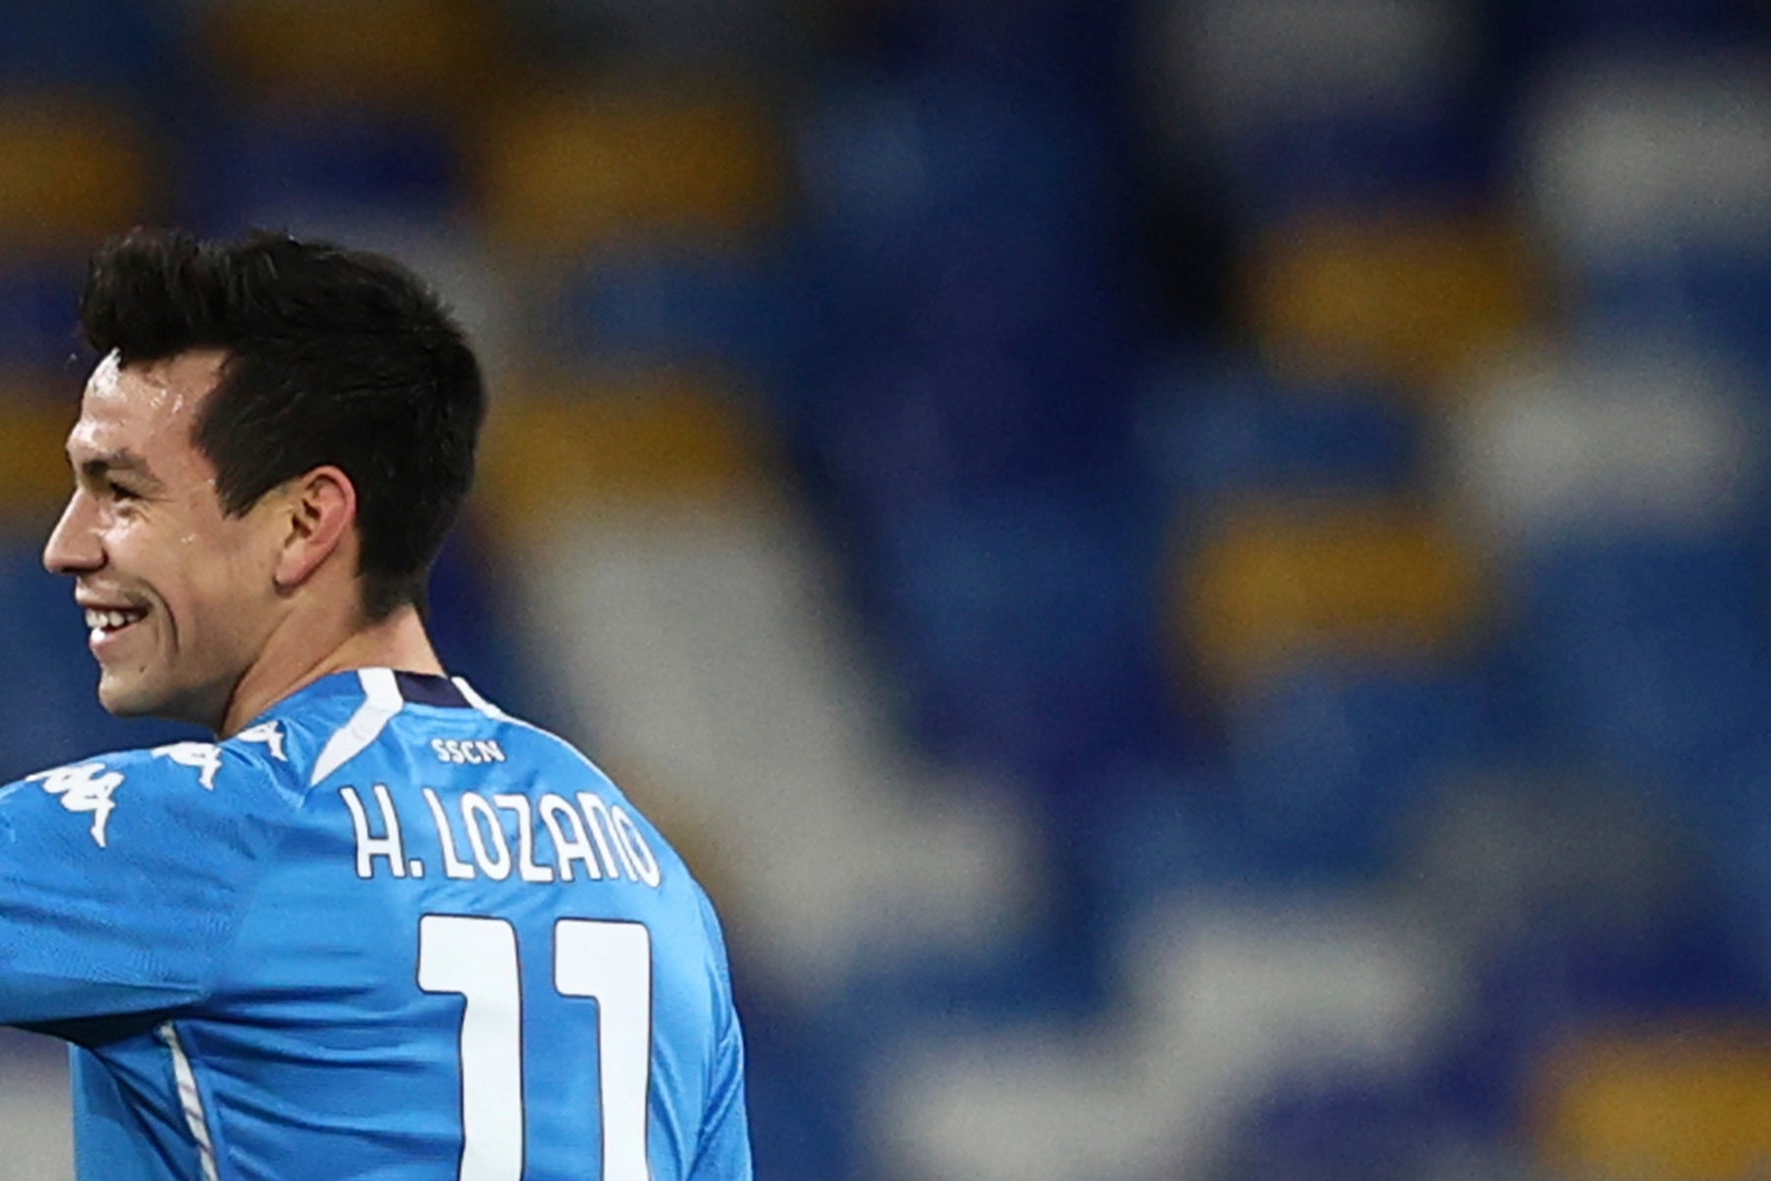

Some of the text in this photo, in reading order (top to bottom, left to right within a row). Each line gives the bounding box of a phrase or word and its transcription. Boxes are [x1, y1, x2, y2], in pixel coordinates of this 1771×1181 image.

[430, 738, 506, 764] SSCN
[340, 784, 662, 888] H. LOZANO
